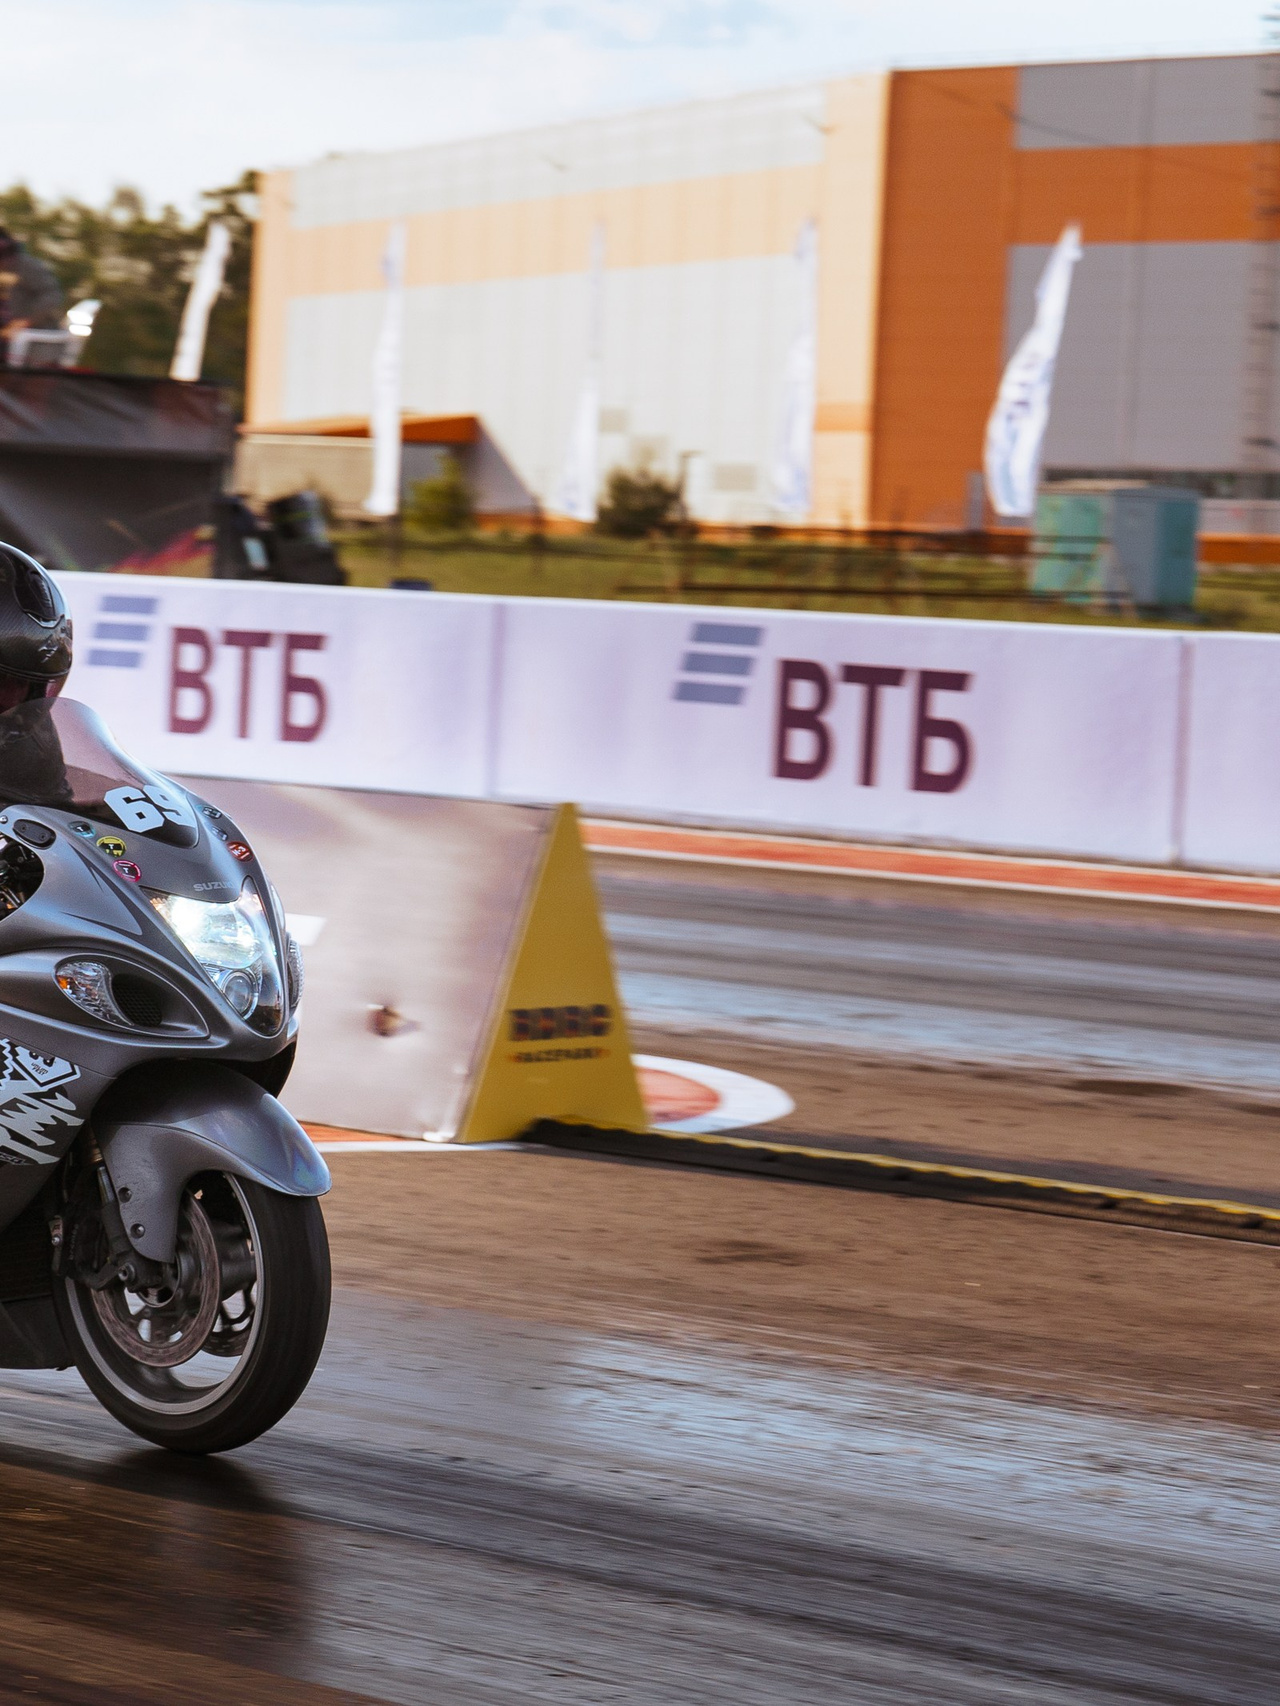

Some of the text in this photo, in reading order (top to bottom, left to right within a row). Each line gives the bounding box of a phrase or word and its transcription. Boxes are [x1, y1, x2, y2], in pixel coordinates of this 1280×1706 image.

[168, 626, 328, 743] ВТБ
[771, 658, 977, 794] ВТБ
[104, 784, 197, 833] 69
[193, 880, 238, 892] SUZU
